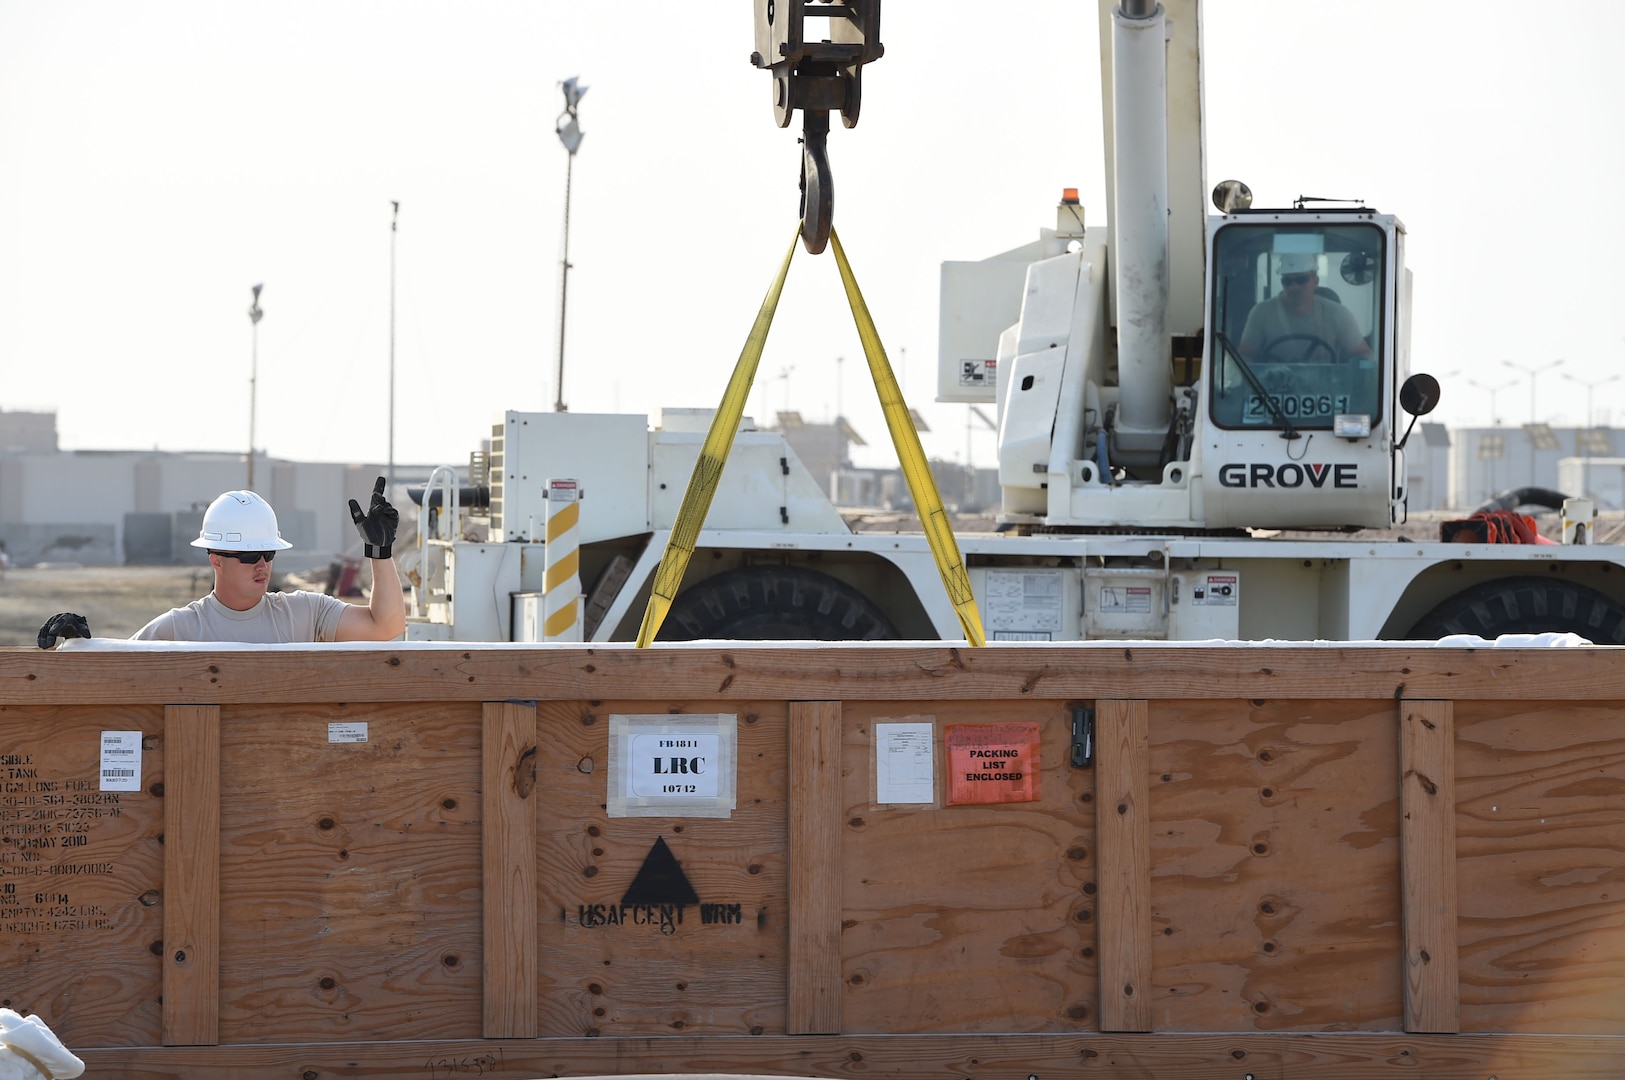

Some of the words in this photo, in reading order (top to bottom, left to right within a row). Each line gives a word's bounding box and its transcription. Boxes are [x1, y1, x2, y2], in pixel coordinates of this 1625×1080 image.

[1219, 464, 1358, 488] GROVE
[659, 740, 698, 748] FB4811
[970, 749, 1019, 758] PACKING
[652, 756, 706, 774] LRC
[983, 761, 1006, 770] LIST
[8, 768, 38, 779] TANK
[966, 772, 1023, 781] ENCLOSED
[662, 784, 697, 793] 10742
[0, 823, 51, 835] CTURER:
[61, 835, 87, 847] 2010
[0, 852, 17, 863] CT
[21, 851, 40, 862] NO:
[1, 894, 19, 905] NO.
[35, 893, 44, 903] 6
[58, 894, 69, 905] 14
[1, 907, 43, 919] EMPTY:
[47, 906, 76, 917] 4242
[80, 905, 106, 916] LBS.
[701, 903, 742, 924] WRM
